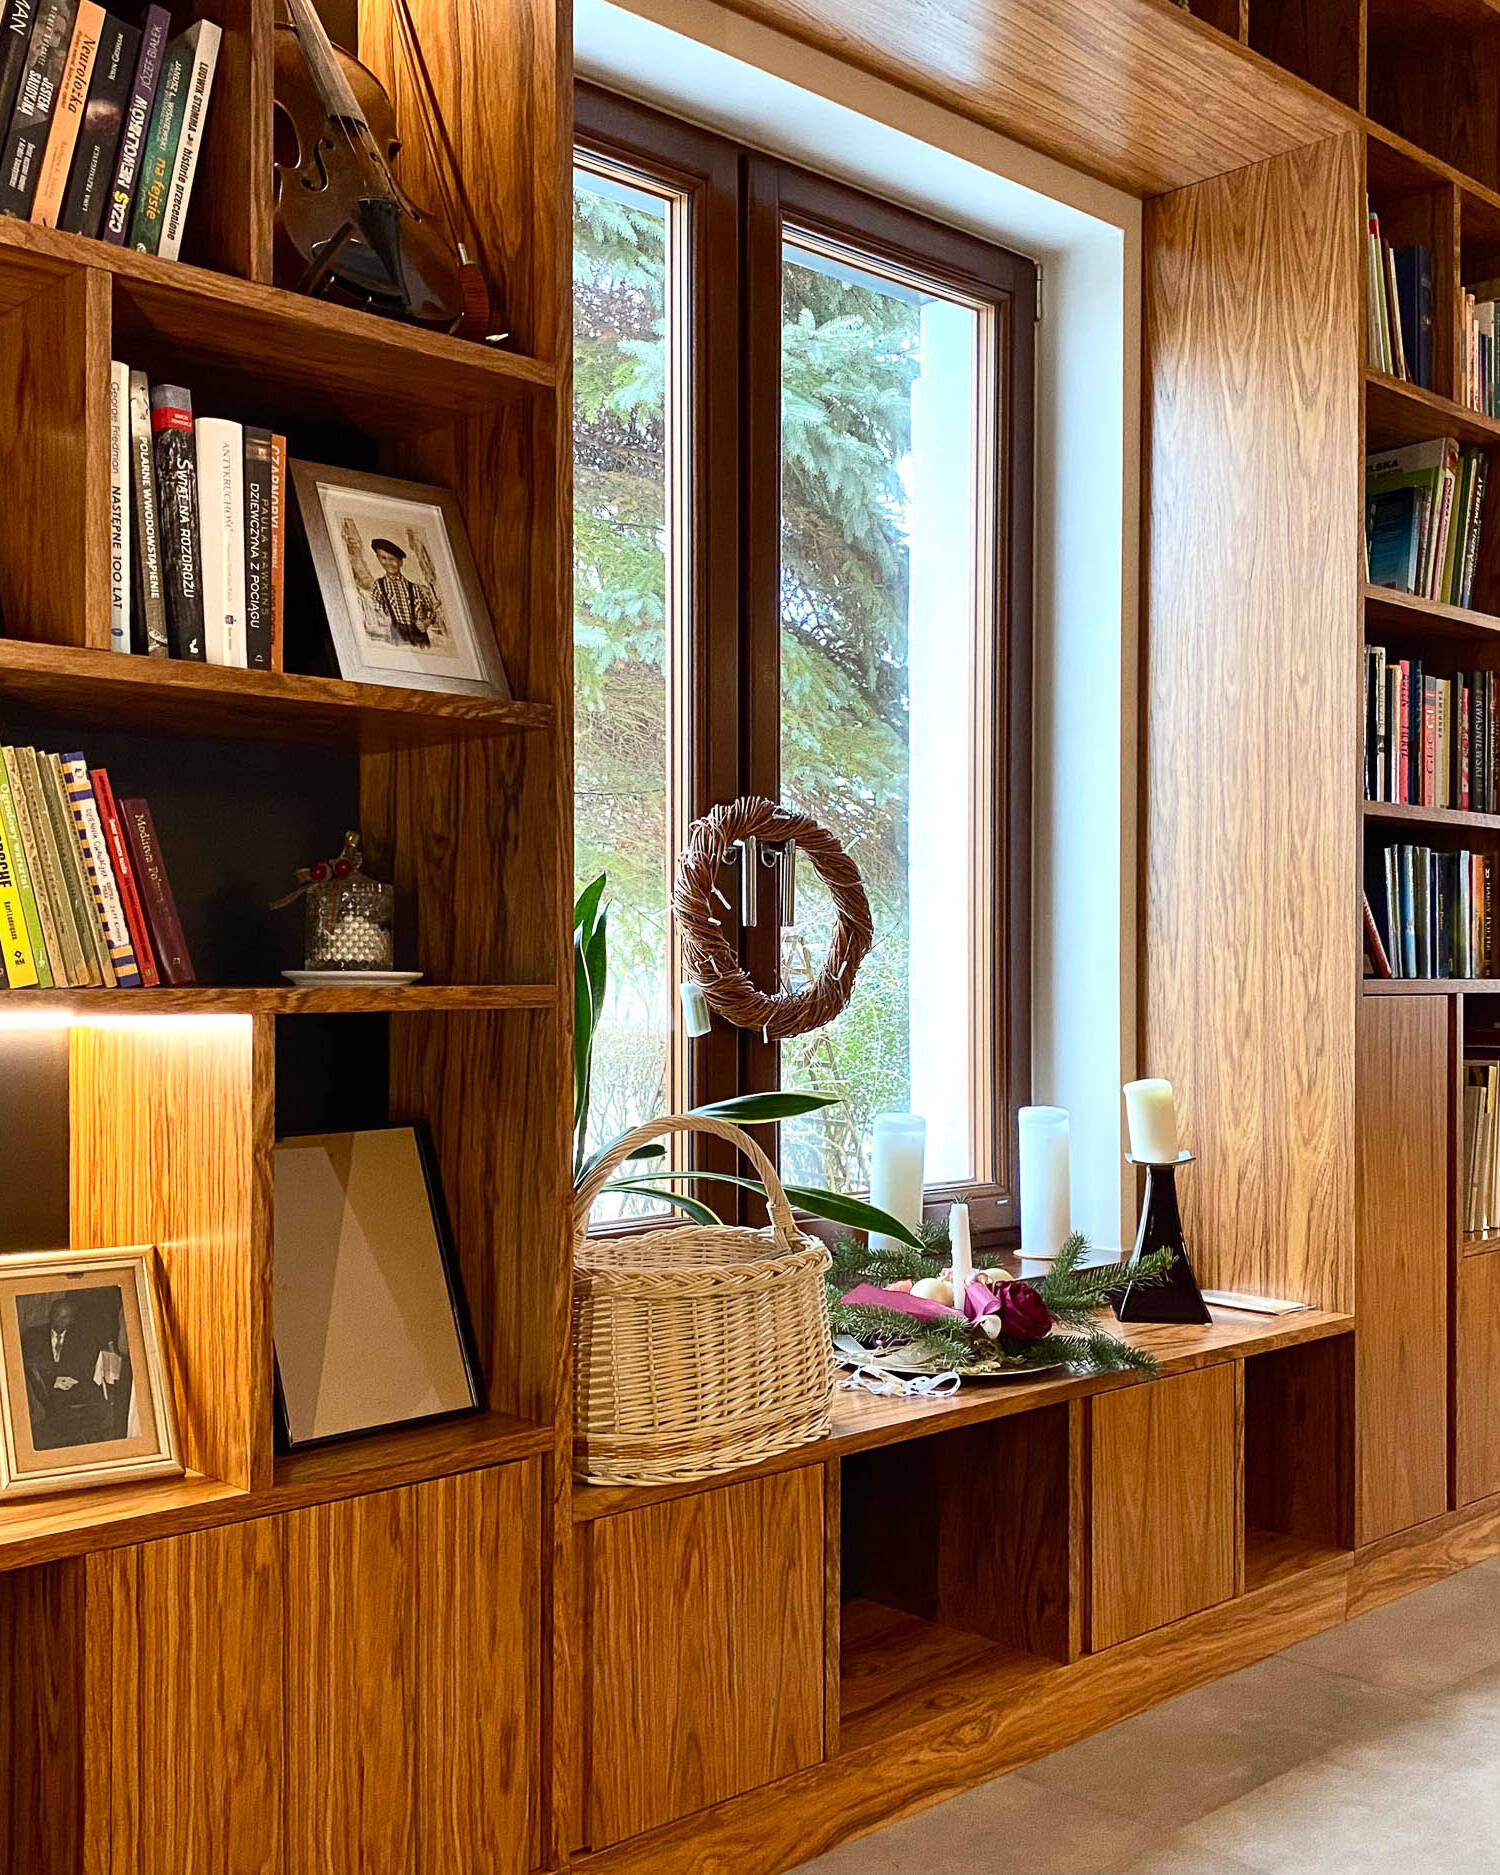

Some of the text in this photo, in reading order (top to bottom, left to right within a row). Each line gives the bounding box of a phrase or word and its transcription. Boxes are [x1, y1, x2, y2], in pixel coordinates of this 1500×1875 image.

[17, 69, 42, 117] SAUDYJKĄ
[36, 77, 54, 113] JESTEM
[68, 34, 97, 115] Neurolożka
[187, 61, 210, 135] LUDWIK STOMMA
[116, 94, 148, 190] NIEWOLNIKÓW
[152, 156, 167, 178] na
[109, 190, 129, 234] CZAS
[146, 178, 165, 221] fejsie
[167, 147, 194, 242] historie przecenione
[111, 380, 120, 474] George Friedman
[138, 435, 151, 491] POLARNE
[110, 485, 123, 610] NASTĘPNE 100 LAT
[178, 503, 191, 524] NA
[180, 527, 195, 599] ROZDROŻU
[248, 482, 260, 629] DZIEWCZYNA Z POCIĄGU
[260, 498, 269, 618] PAULA HAWKINS
